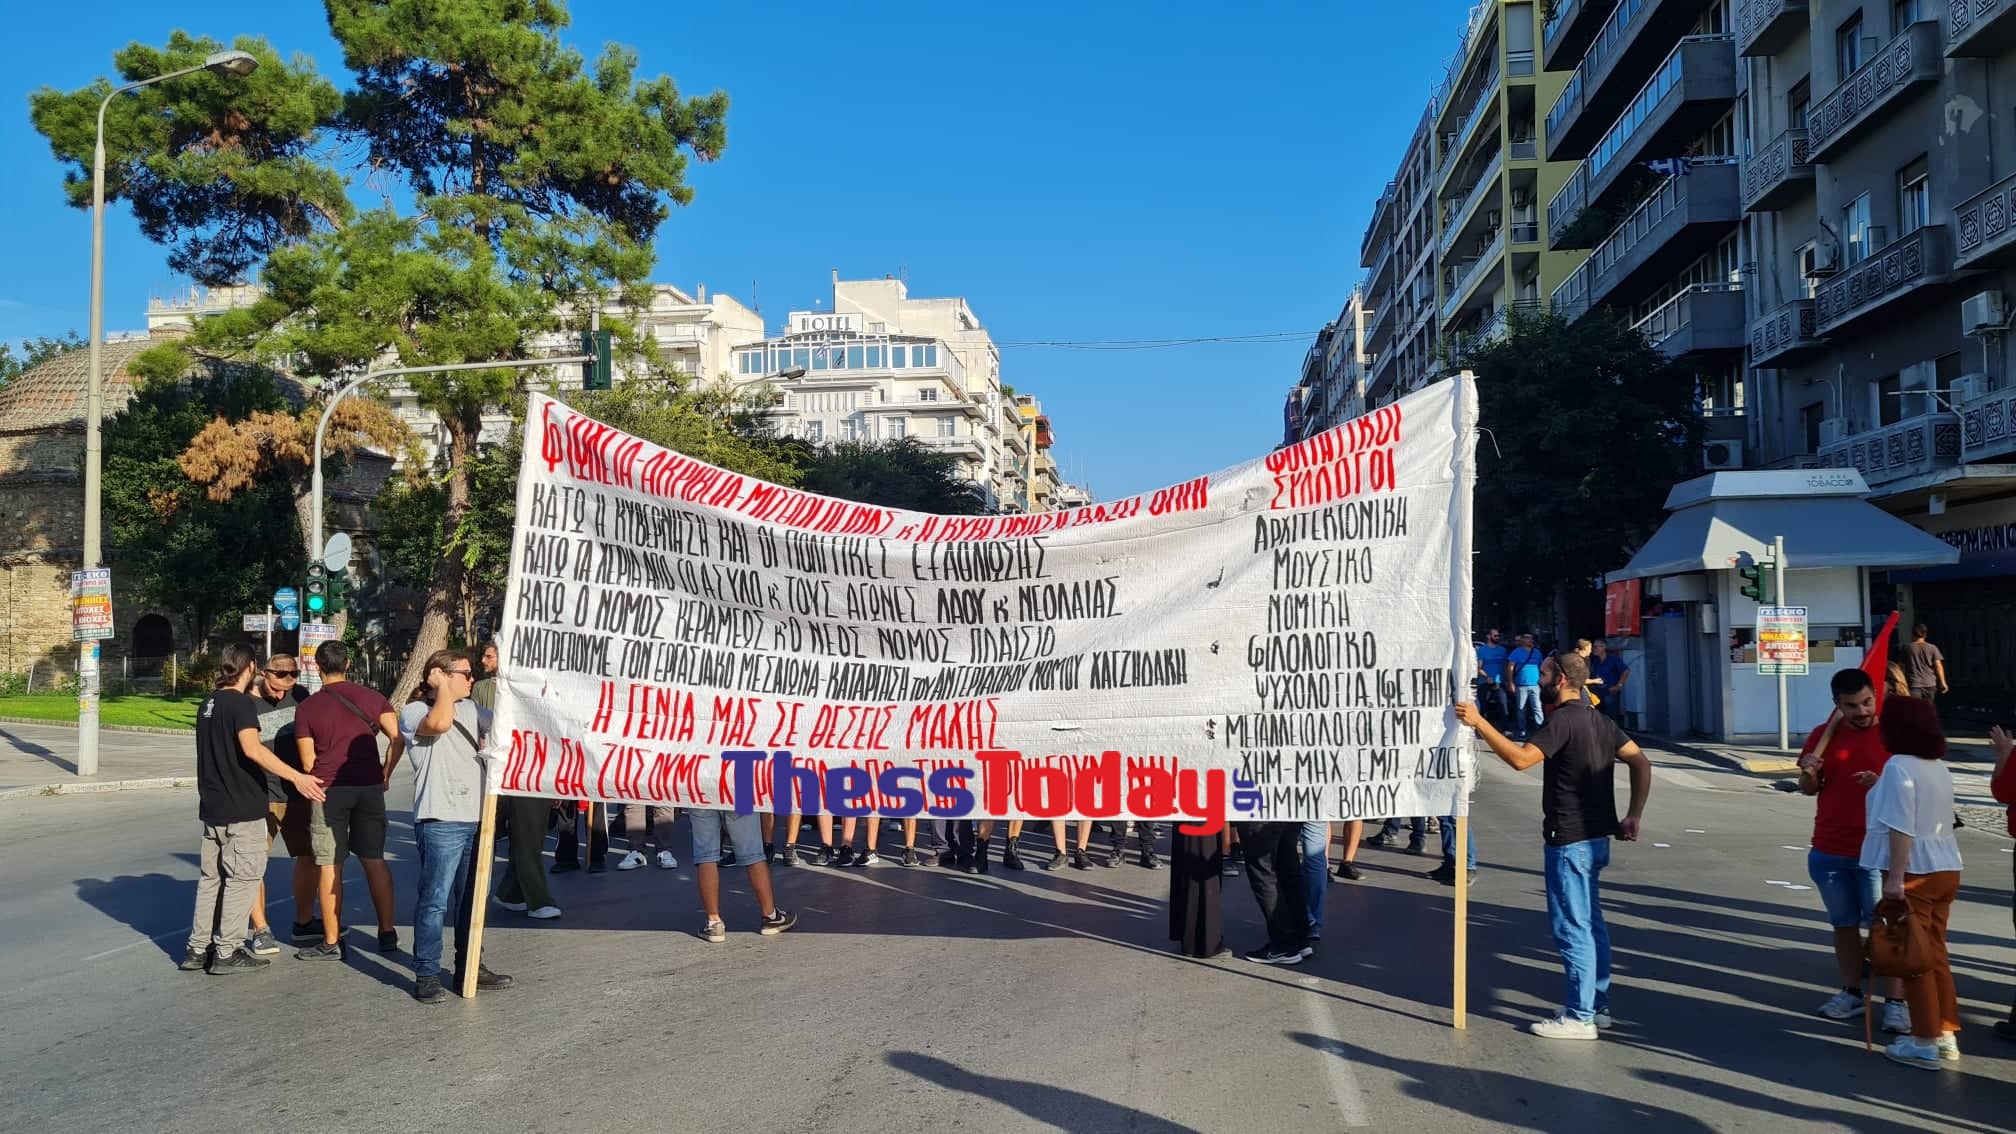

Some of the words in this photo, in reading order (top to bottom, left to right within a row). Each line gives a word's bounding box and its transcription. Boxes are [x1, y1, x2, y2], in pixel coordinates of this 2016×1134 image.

[801, 316, 853, 331] HOTEL
[530, 483, 586, 533] ΚΑΤΩ
[596, 493, 605, 538] Η
[615, 497, 710, 558] ΚΥΒΕΡΝΗΣΗ
[717, 518, 751, 565] ΚΑΙ
[757, 525, 779, 569] ΟΙ
[785, 530, 896, 580] ΠΟΛΙΤΙΚΕΣ
[912, 536, 1051, 582] ΕΞΑΘΛΙΩΣΗΣ
[522, 532, 570, 579] ΚΑΤΩ
[573, 538, 593, 583] ΤΑ
[595, 542, 641, 588] ΧΕΡΙΑ
[643, 550, 676, 592] ΑΠΟ
[784, 575, 838, 619] ΤΟΥΣ
[847, 582, 925, 623] ΑΓΩΝΕΣ
[937, 587, 986, 625] ΛΑΟΥ
[1018, 576, 1122, 622] ΝΕΟΛΑΙΑΣ
[1273, 546, 1373, 590] ΜΟΥΣΙΚΟ
[516, 578, 566, 625] ΚΑΤΩ
[574, 584, 591, 627] Ο
[595, 589, 670, 640] ΝΟΜΟΣ
[675, 598, 769, 652] ΚΕΡΑΜΕΩΣ
[808, 620, 867, 659] ΝΕΟΣ
[878, 627, 957, 664] ΝΟΜΟΣ
[970, 625, 1056, 664] ΠΛΑΙΣΙΟ
[1268, 589, 1350, 633] ΝΟΜΙΚΗ
[509, 624, 614, 677] ΑΝΑΤΡΕΠΟΥΜΕ
[619, 638, 654, 680] ΤΟΝ
[1028, 653, 1084, 692] ΝΟΜΟΥ
[1090, 648, 1188, 690] ΧΑΤΖΗΔΑΚΗ
[1248, 631, 1377, 673] ΦΙΛΟΛΟΓΙΚΟ
[592, 680, 615, 733] Η
[622, 683, 696, 743] ΓΕΝΙΑ
[706, 695, 762, 748] ΜΑΣ
[768, 701, 806, 748] ΣΕ
[808, 703, 898, 750] ΘΕΣΕΙΣ
[905, 697, 1007, 750] ΜΑΧΗΣ
[1381, 709, 1421, 747] ΕΜΠ
[501, 729, 548, 793] ΔΕΝ
[555, 737, 588, 797] ΘΑ
[597, 743, 712, 804] ΖΗΣΟΥΜΕ
[1357, 748, 1400, 781] ΕΜΠ
[1339, 782, 1401, 820] ΒΟΛΟΥ
